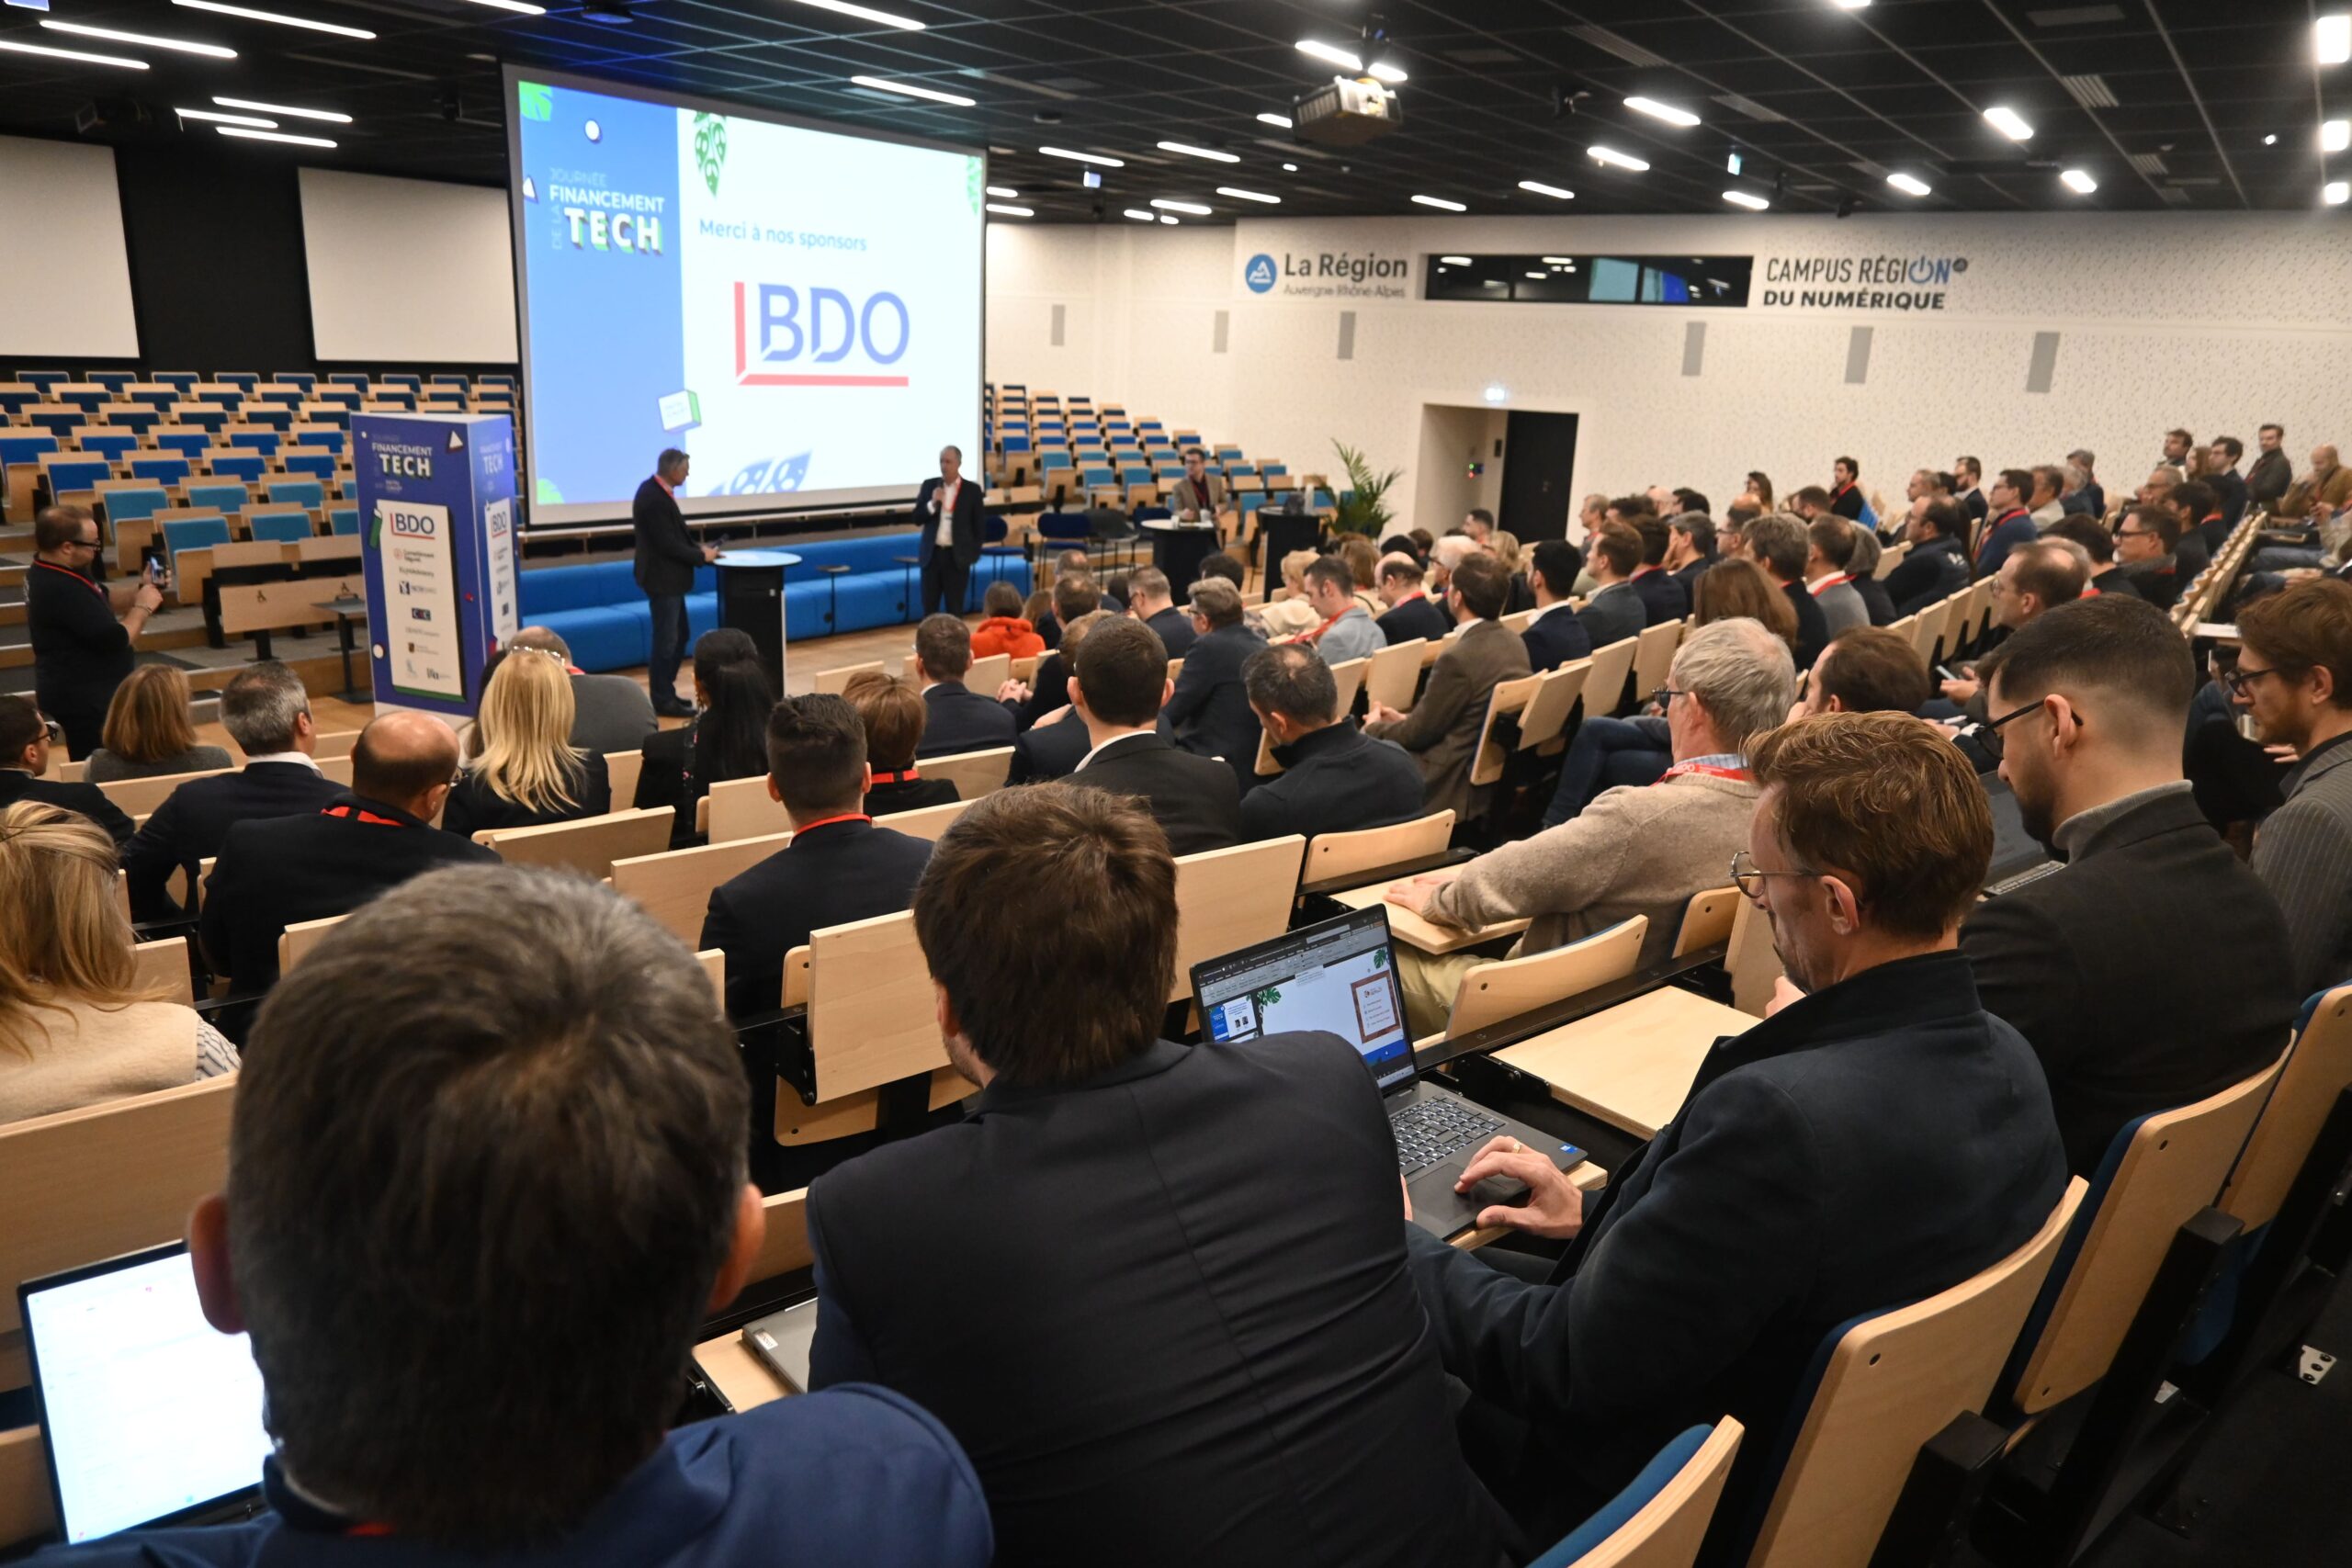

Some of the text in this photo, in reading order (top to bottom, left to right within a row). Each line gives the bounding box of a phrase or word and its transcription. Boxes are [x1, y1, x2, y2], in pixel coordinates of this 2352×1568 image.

[549, 184, 665, 213] FINANCEMENT
[563, 207, 661, 253] TECH
[699, 218, 867, 252] Merci à nos sponsors
[1285, 253, 1408, 283] La Région
[1766, 257, 1854, 284] CAMPUS
[1763, 288, 1946, 310] DU NUMÉRIQUE
[758, 282, 910, 365] BDO
[371, 442, 433, 457] FINANCEMENT
[379, 453, 431, 478] TECH
[395, 513, 435, 535] BDO
